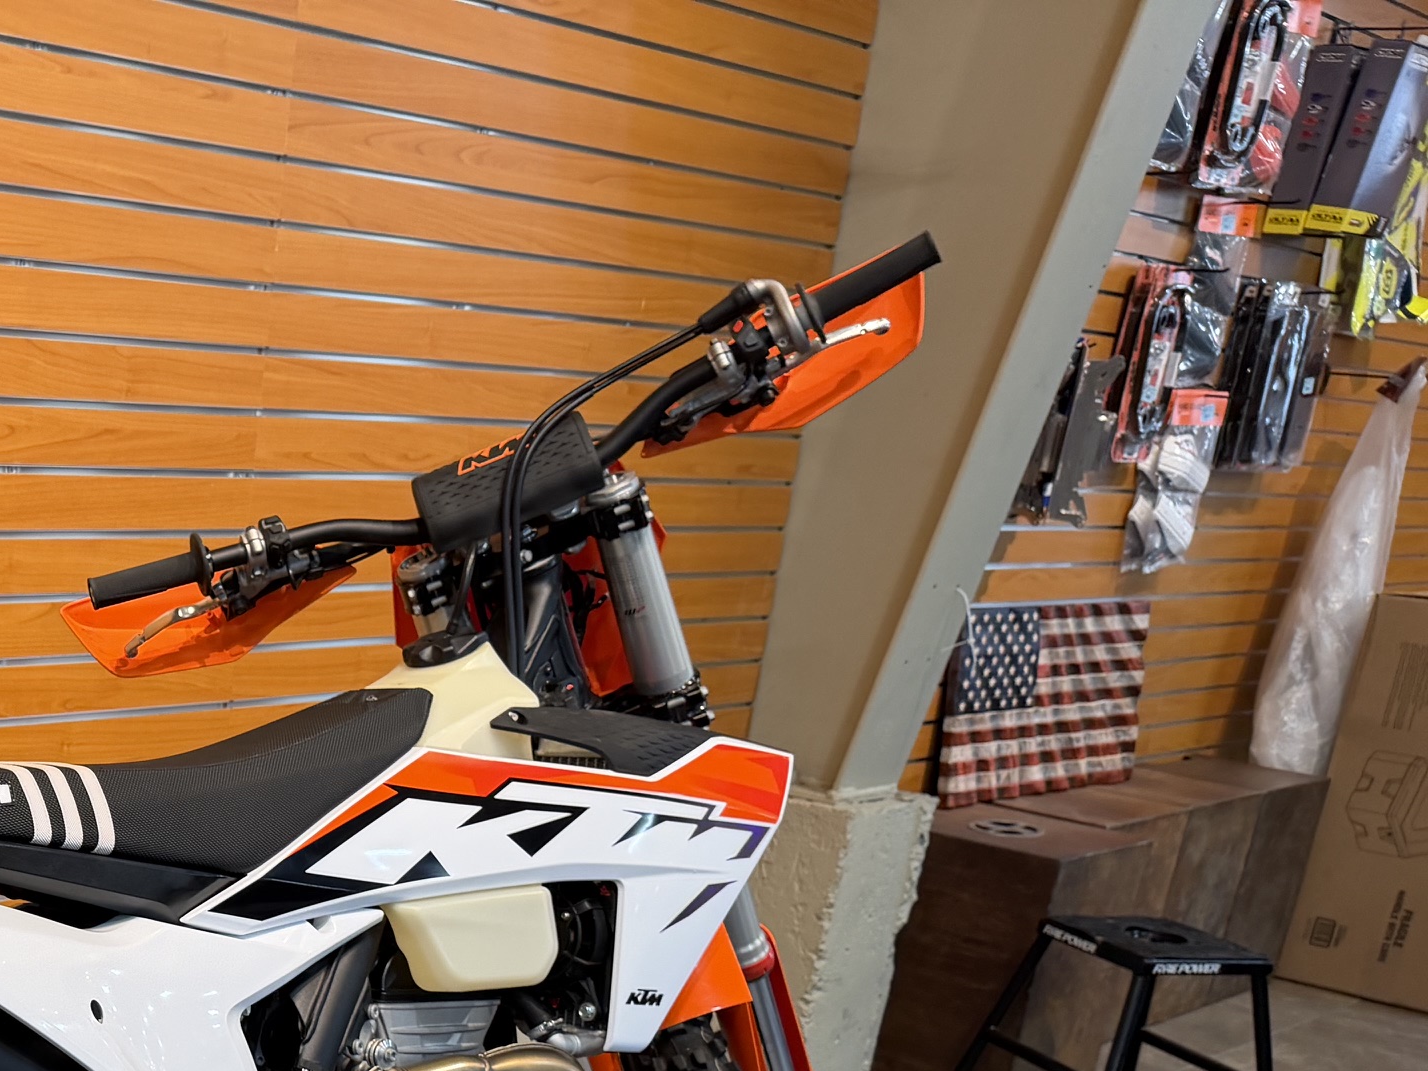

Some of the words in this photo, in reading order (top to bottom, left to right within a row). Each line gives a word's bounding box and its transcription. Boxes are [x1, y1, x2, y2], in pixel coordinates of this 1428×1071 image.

[457, 432, 536, 476] KT
[306, 780, 770, 884] KTM
[626, 988, 662, 1006] KTM
